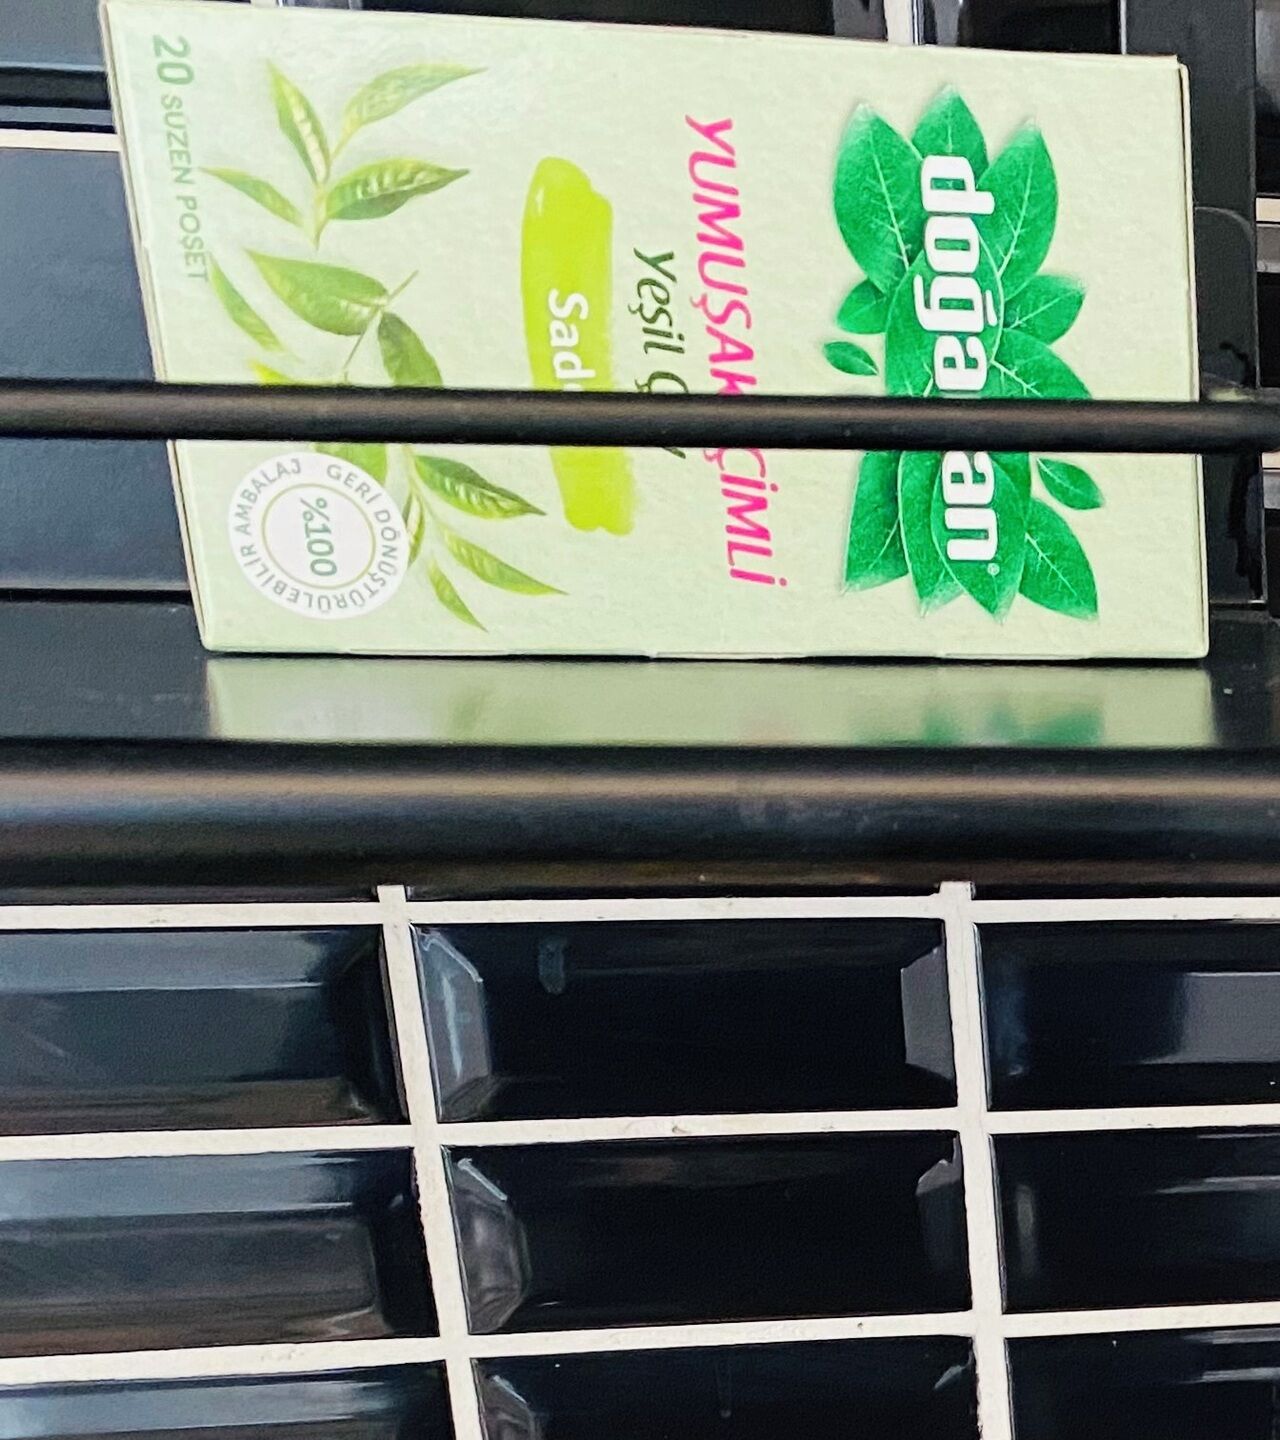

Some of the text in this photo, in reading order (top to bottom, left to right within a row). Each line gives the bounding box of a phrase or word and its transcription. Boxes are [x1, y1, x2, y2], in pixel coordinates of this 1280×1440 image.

[152, 34, 195, 86] 20
[176, 194, 209, 283] POŞET
[548, 287, 596, 391] Sad
[628, 248, 686, 356] Yeşil
[914, 154, 997, 561] doğaan
[235, 458, 301, 536] AMBALAJ
[300, 497, 338, 577] %100
